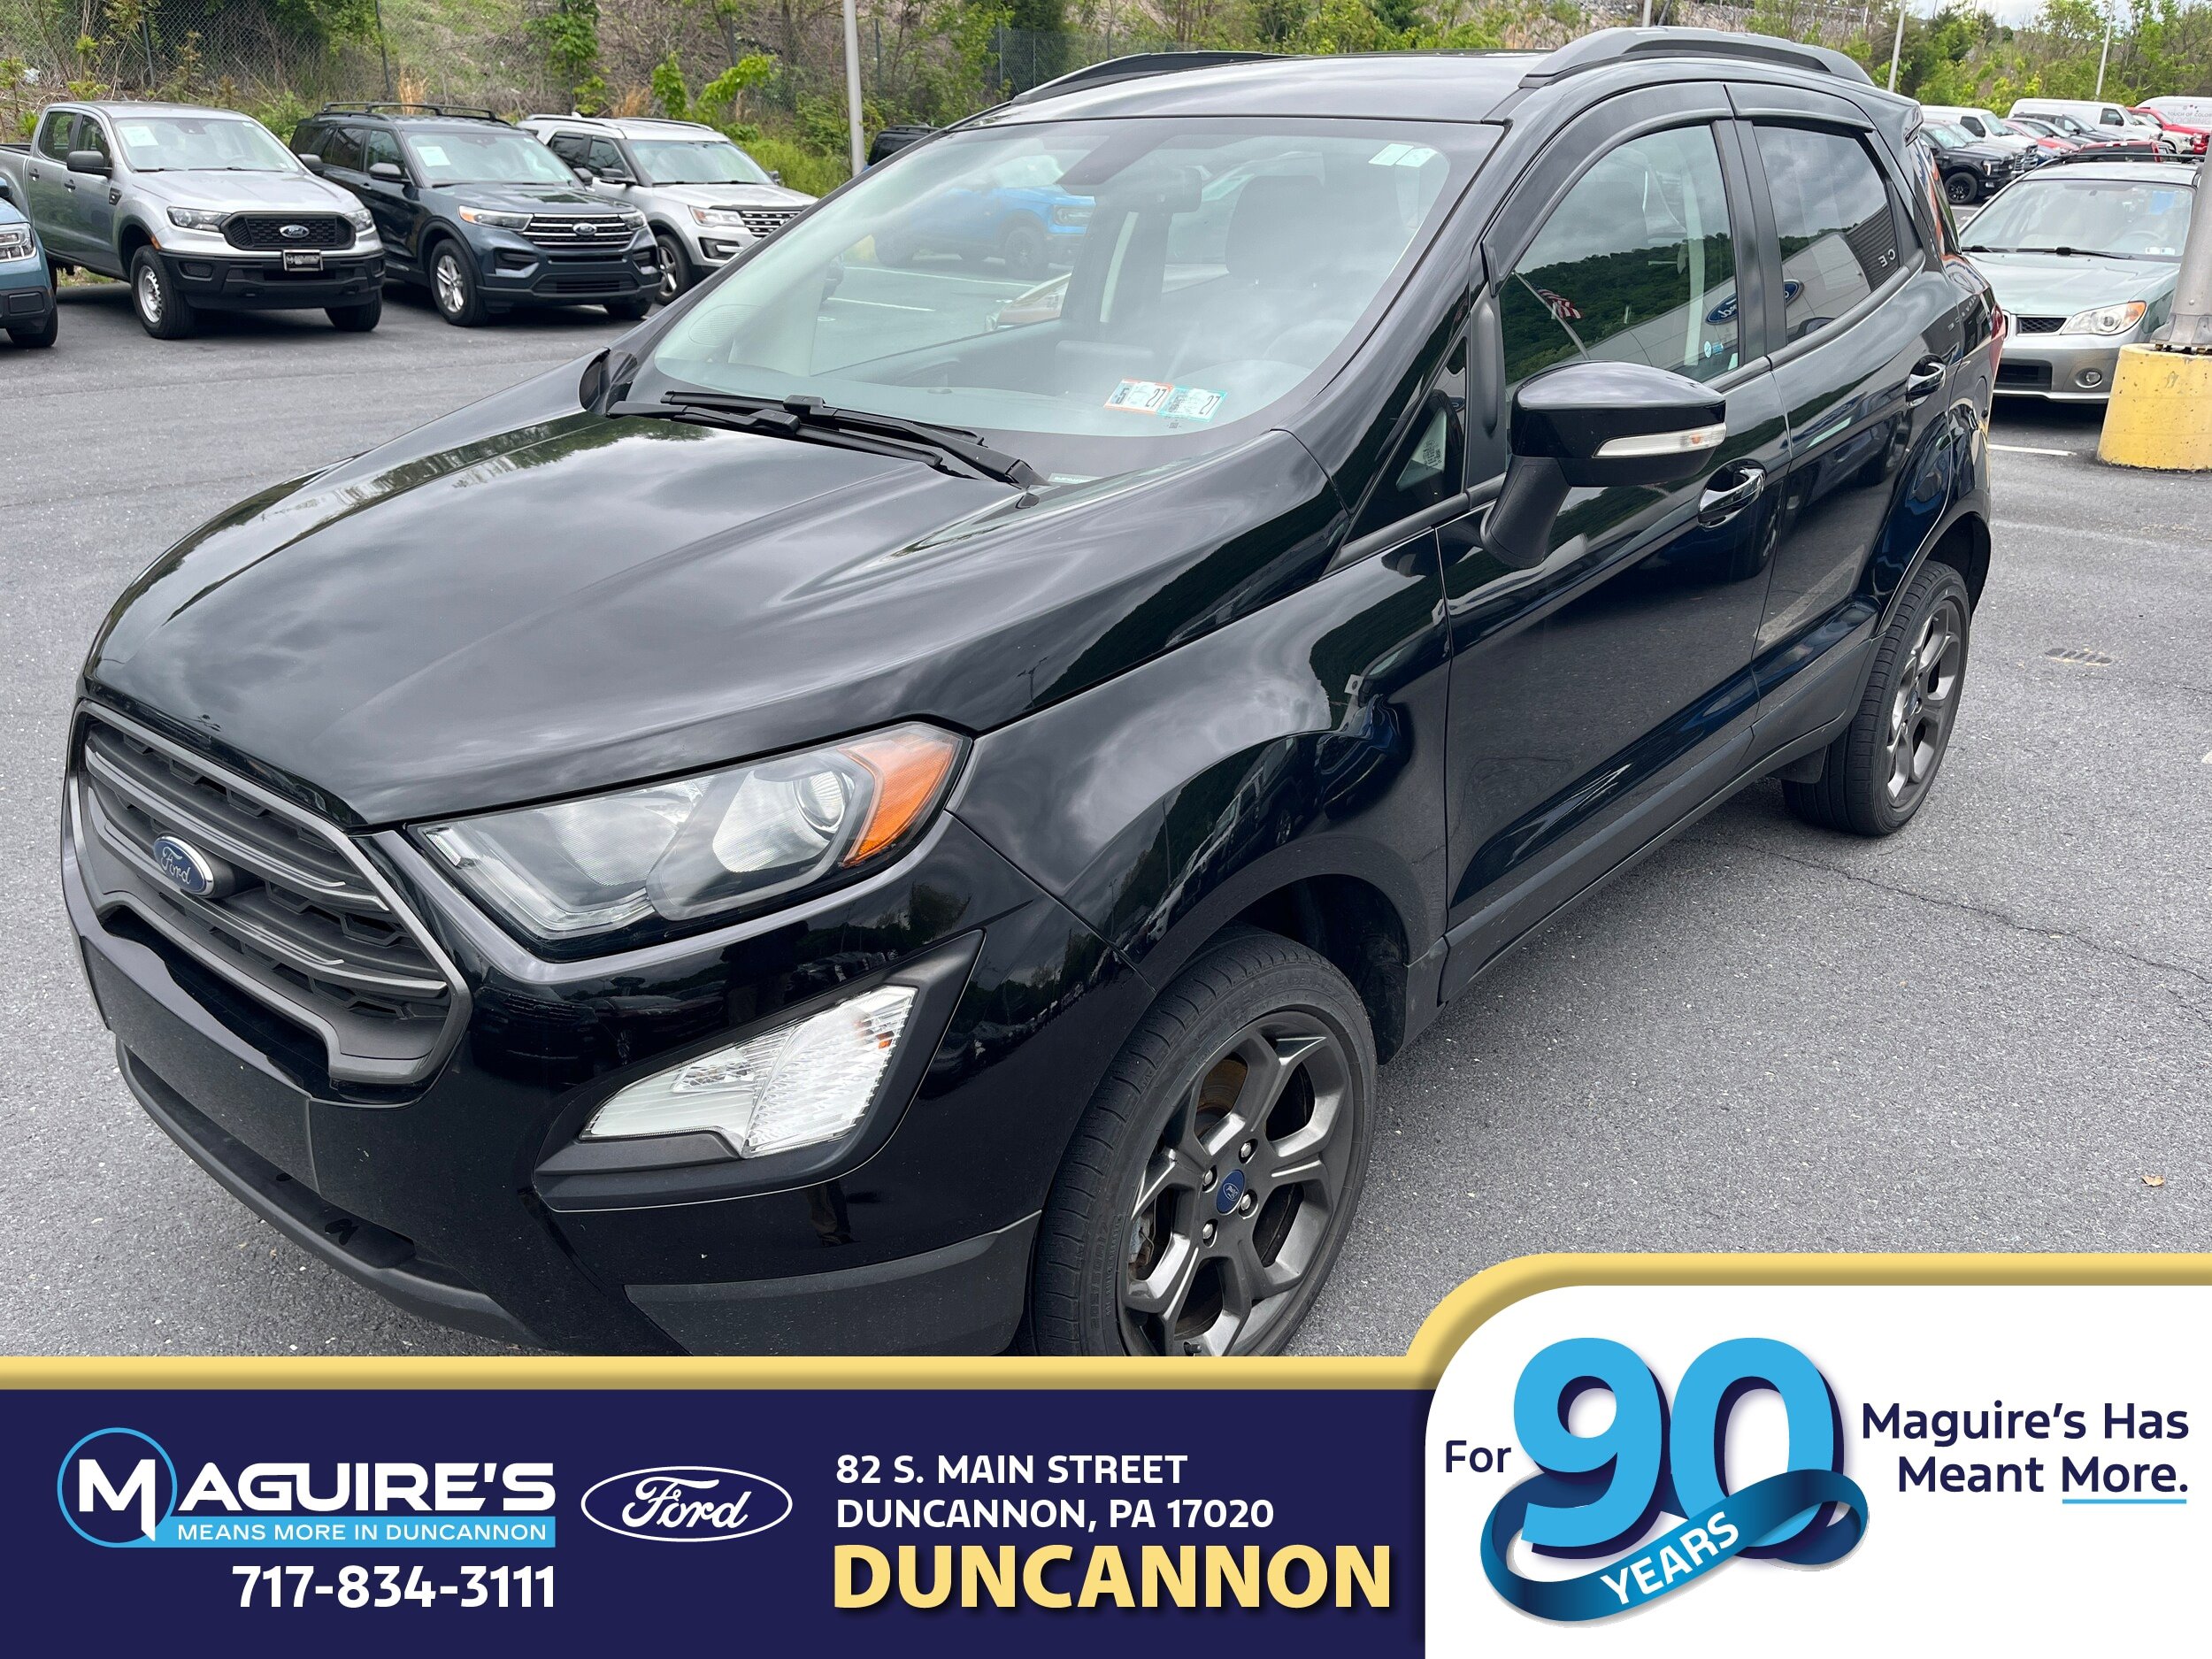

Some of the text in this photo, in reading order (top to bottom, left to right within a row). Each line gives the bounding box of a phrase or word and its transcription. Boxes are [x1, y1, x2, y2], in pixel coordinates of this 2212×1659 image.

[1145, 388, 1167, 407] 27
[1199, 396, 1221, 416] 27
[161, 846, 192, 885] Ford
